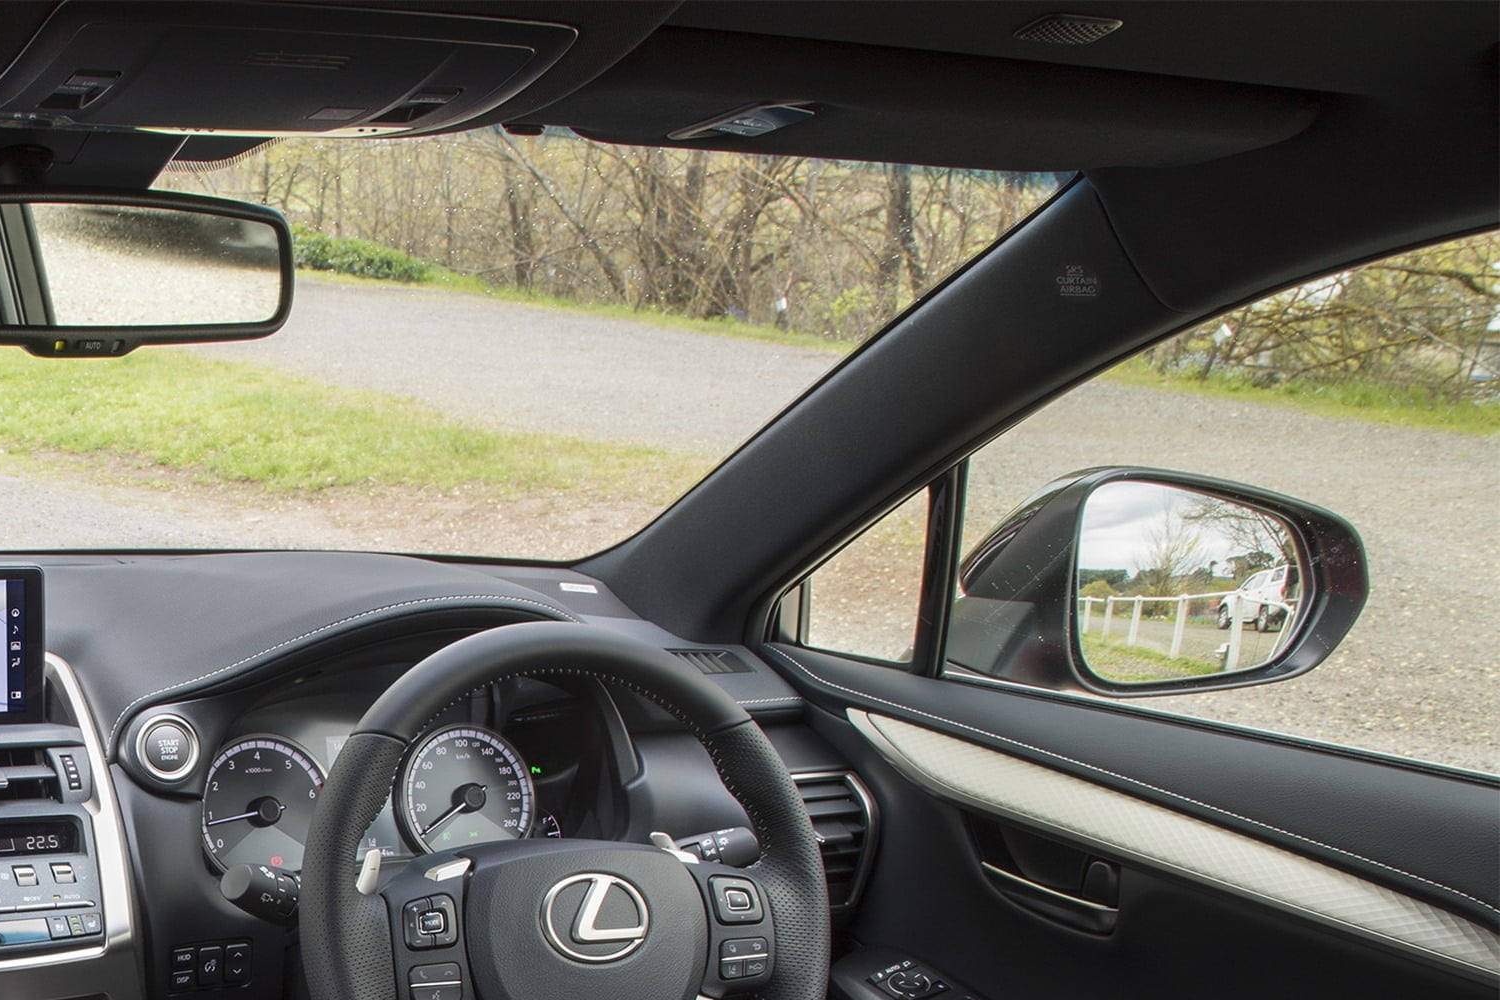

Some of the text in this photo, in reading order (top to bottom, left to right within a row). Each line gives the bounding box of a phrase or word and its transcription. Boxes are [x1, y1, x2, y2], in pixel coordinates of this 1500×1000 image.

[1066, 264, 1084, 274] SRS
[1056, 276, 1097, 285] CURTAIN
[1060, 285, 1096, 294] AIRBAG
[85, 341, 101, 350] AUTO
[158, 738, 179, 747] START
[455, 739, 468, 748] 100
[254, 751, 261, 760] 4
[435, 747, 447, 755] 80
[481, 747, 494, 756] 140
[228, 760, 235, 770] 3
[285, 760, 292, 769] 5
[422, 762, 433, 770] 60
[499, 766, 512, 775] 180
[212, 782, 219, 791] 2
[415, 781, 426, 789] 40
[309, 789, 316, 799] 6
[507, 792, 521, 800] 220
[416, 803, 427, 812] 20
[503, 819, 518, 828] 260
[26, 834, 59, 850] 22.5
[216, 839, 224, 848] 0
[177, 953, 192, 962] HUD
[176, 975, 190, 984] DISP
